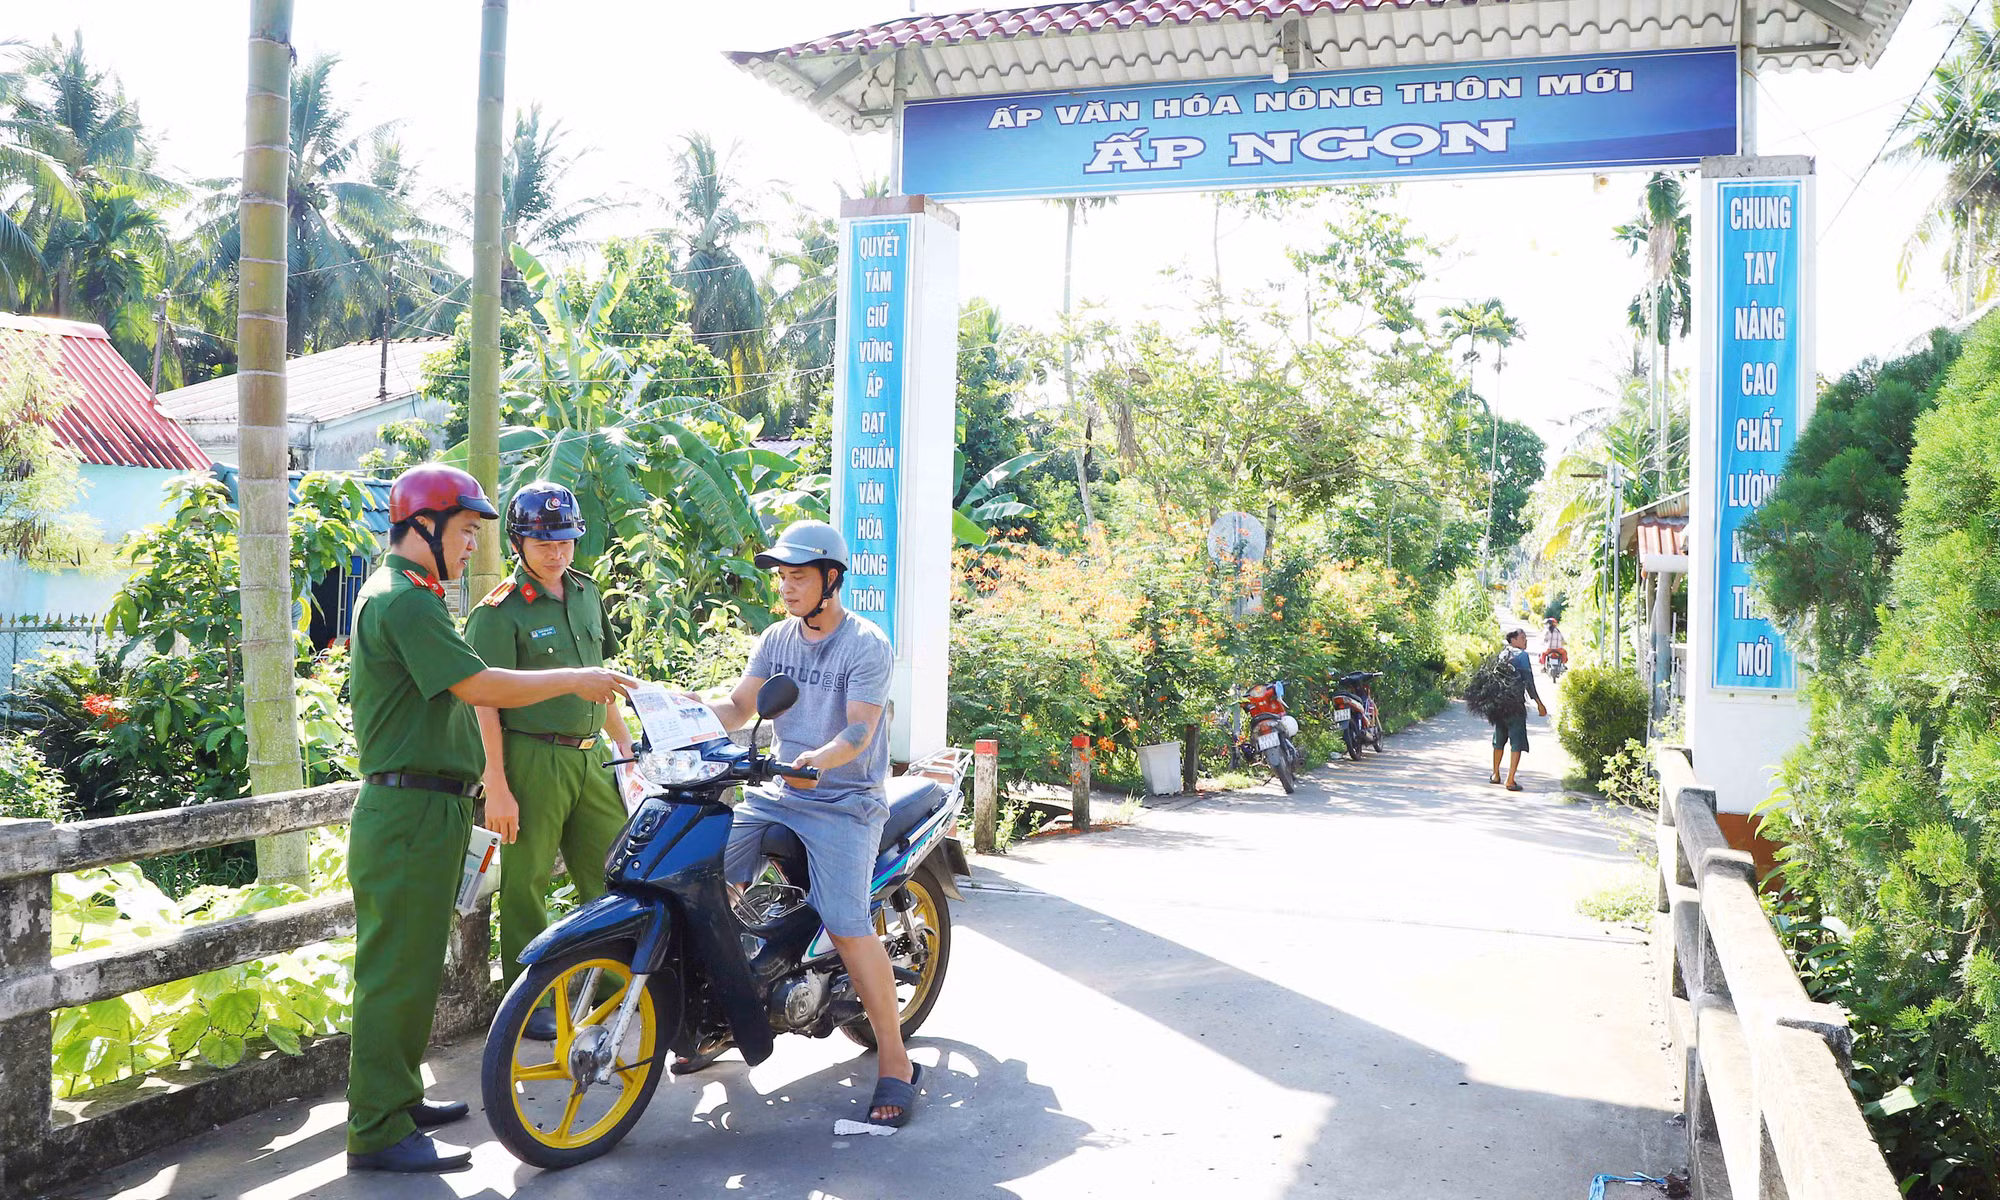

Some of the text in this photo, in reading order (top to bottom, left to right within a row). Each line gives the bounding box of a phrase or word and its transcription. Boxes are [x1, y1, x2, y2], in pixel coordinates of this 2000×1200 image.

[988, 68, 1634, 129] ẤP VĂN HÓA NÔNG THÔN MỚI
[1083, 118, 1516, 174] ẤP NGỌN
[1730, 195, 1792, 231] CHUNG
[859, 229, 900, 260] QUYẾT
[865, 266, 893, 293] TÂM
[1743, 251, 1777, 285] TAY
[866, 302, 889, 328] GIỮ
[1734, 299, 1786, 341] NÂNG
[859, 338, 893, 363] VỮNG
[865, 369, 884, 398] ẤP
[1741, 362, 1778, 396] CAO
[861, 411, 887, 438] ĐẠT
[1736, 407, 1783, 452] CHẤT
[851, 439, 894, 469] CHUẨN
[858, 479, 885, 504] VĂN
[857, 513, 884, 540] HÓA
[851, 549, 888, 576] NÔNG
[851, 585, 885, 612] THÔN
[1736, 636, 1773, 677] MỚI
